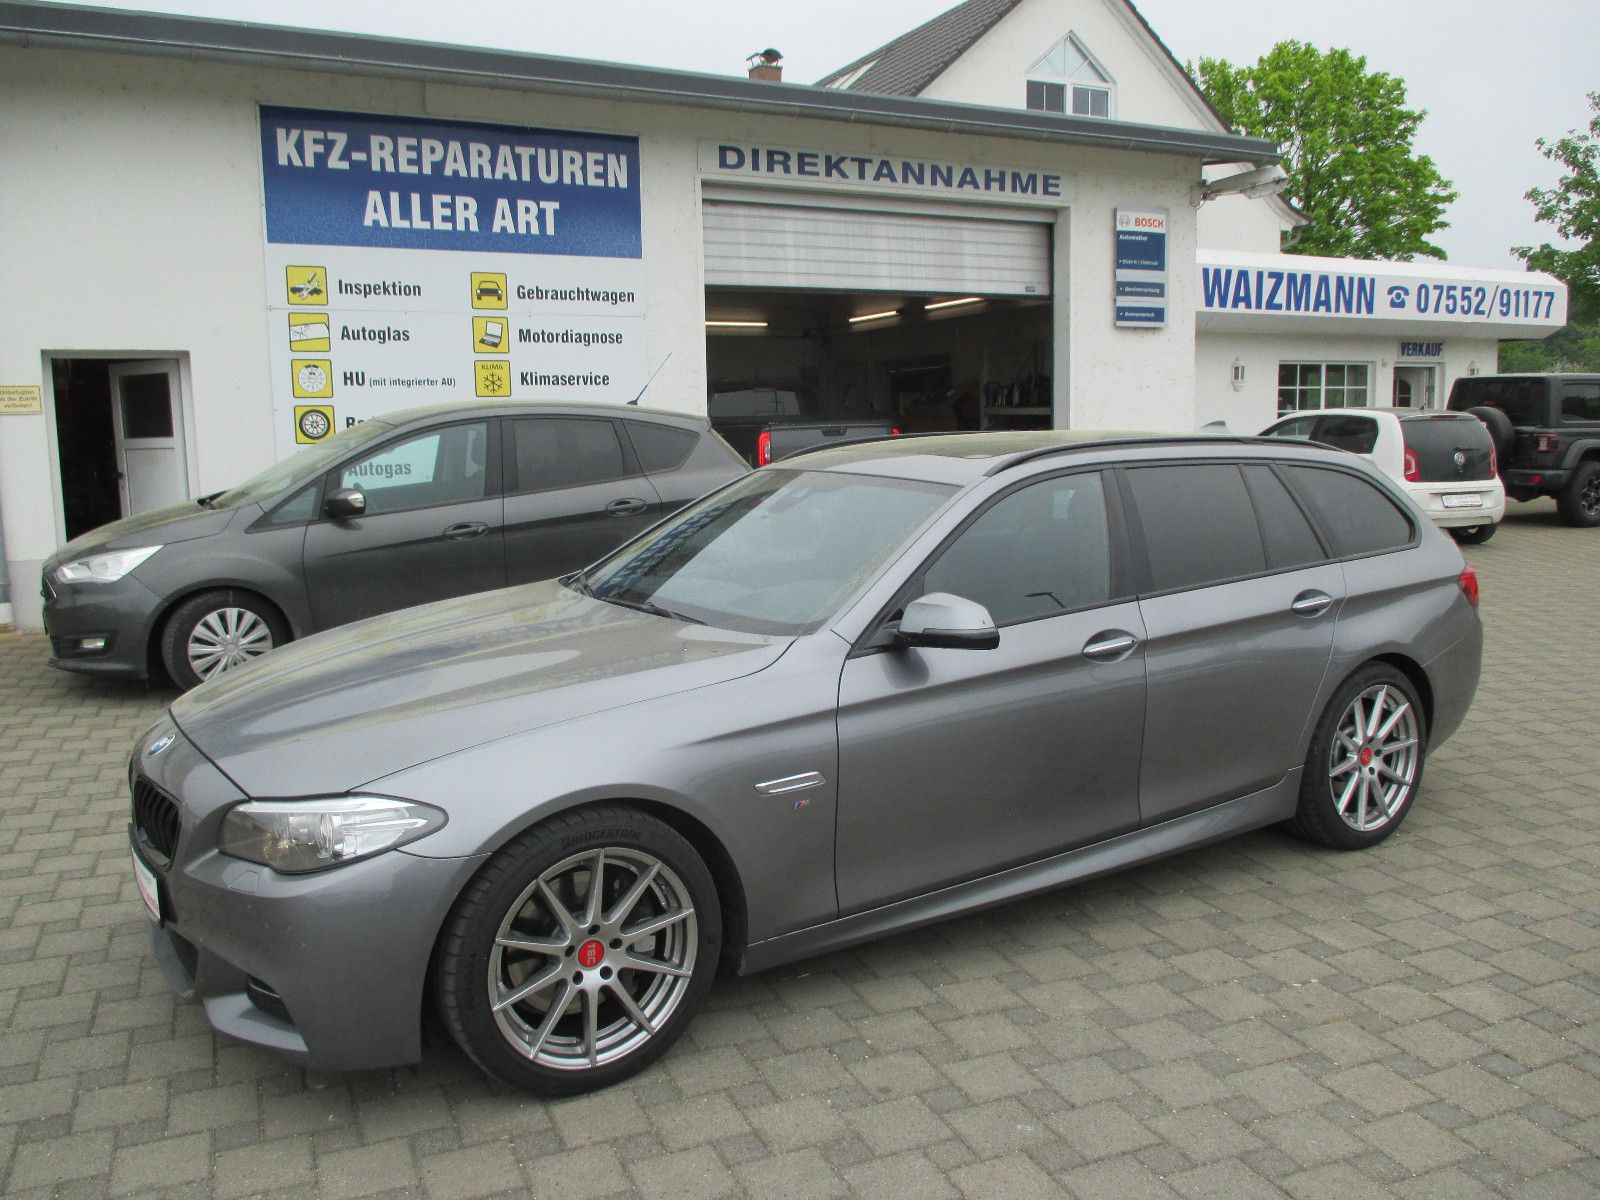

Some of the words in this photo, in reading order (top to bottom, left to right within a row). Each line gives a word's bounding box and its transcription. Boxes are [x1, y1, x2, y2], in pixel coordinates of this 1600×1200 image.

[275, 127, 628, 188] KFZ-REPARATUREN
[718, 145, 1061, 197] DIREKTANNAHME
[363, 190, 479, 232] ALLER
[492, 197, 560, 236] ART
[1134, 217, 1164, 229] BOSCH
[338, 279, 422, 298] Inspektion
[516, 285, 635, 305] Gebrauchtwagen
[1201, 267, 1376, 315] WAIZMANN
[1416, 283, 1555, 320] 07552/91177
[340, 326, 410, 344] Autoglas
[518, 328, 623, 347] Motordiagnose
[1400, 342, 1443, 357] VERKAUF
[343, 371, 366, 387] HU
[369, 377, 387, 388] (mit
[389, 377, 438, 388] integrierter
[441, 377, 456, 388] AU)
[520, 371, 610, 387] Klimaservice
[348, 462, 412, 478] Autogas
